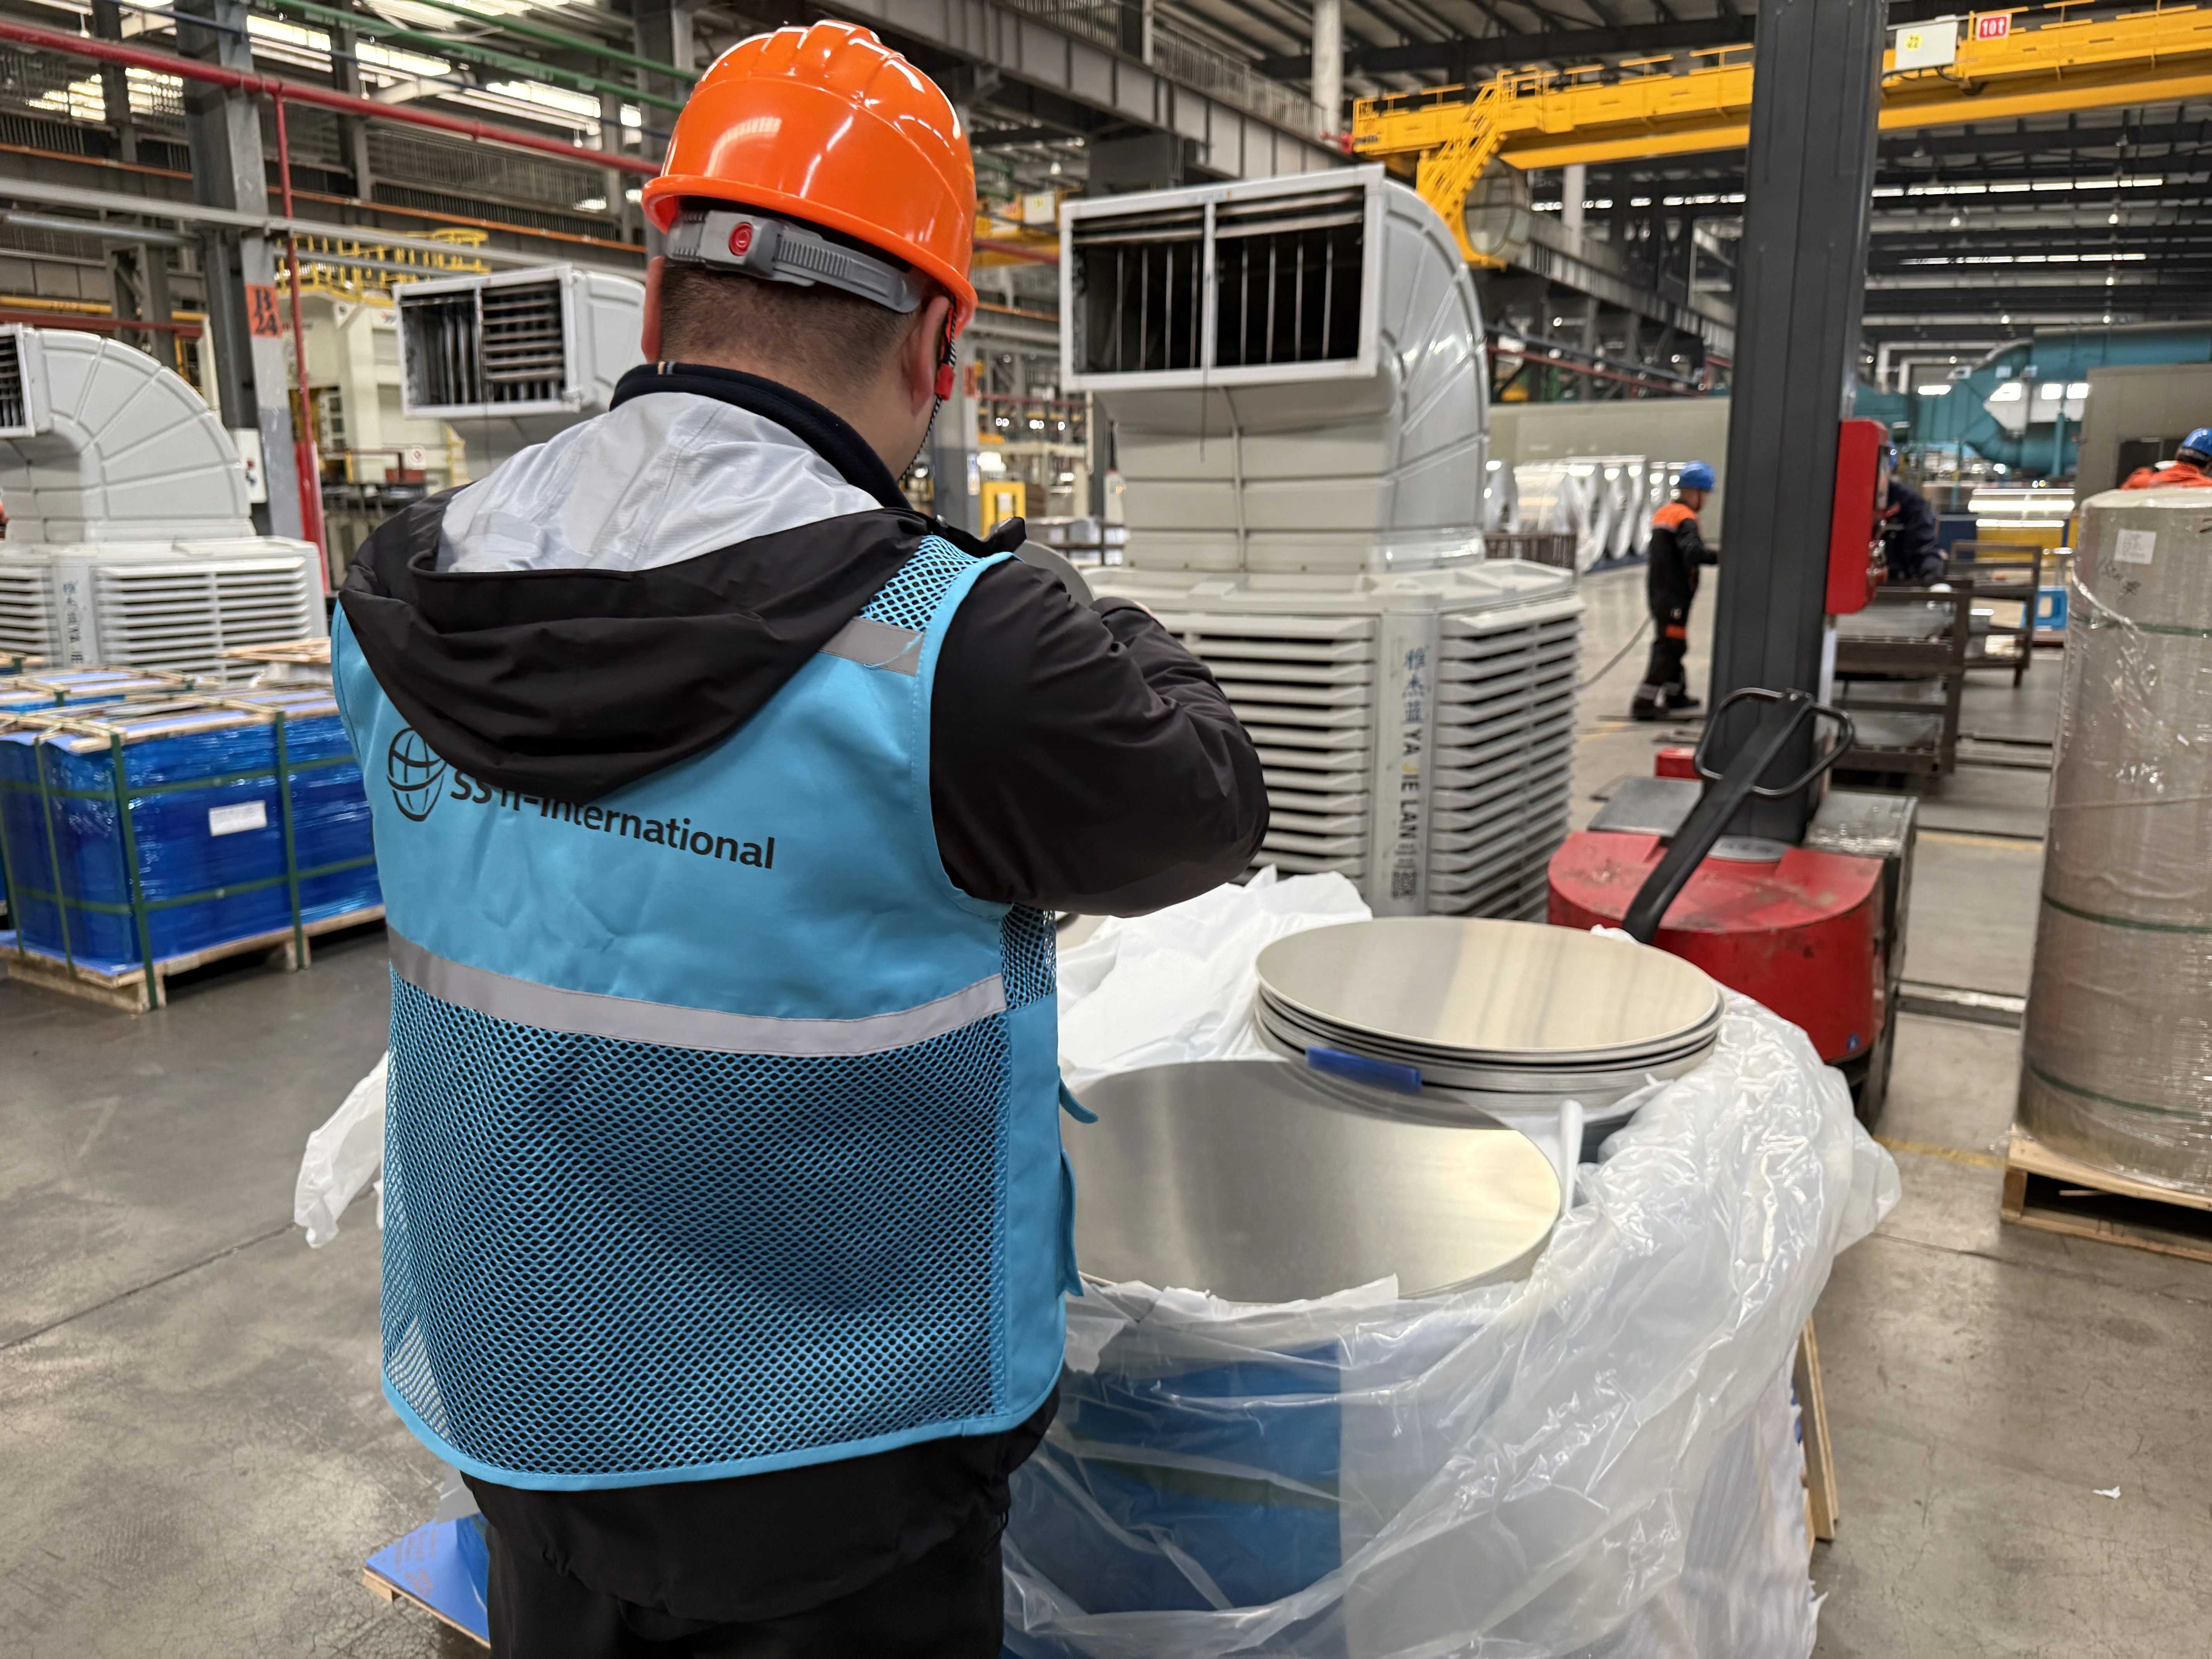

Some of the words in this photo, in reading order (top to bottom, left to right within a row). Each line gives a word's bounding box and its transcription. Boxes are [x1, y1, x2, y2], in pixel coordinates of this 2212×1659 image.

[1982, 18, 2005, 36] 10t
[1402, 728, 1423, 756] YA
[1401, 762, 1421, 792] JIE
[1399, 799, 1419, 839] LAN
